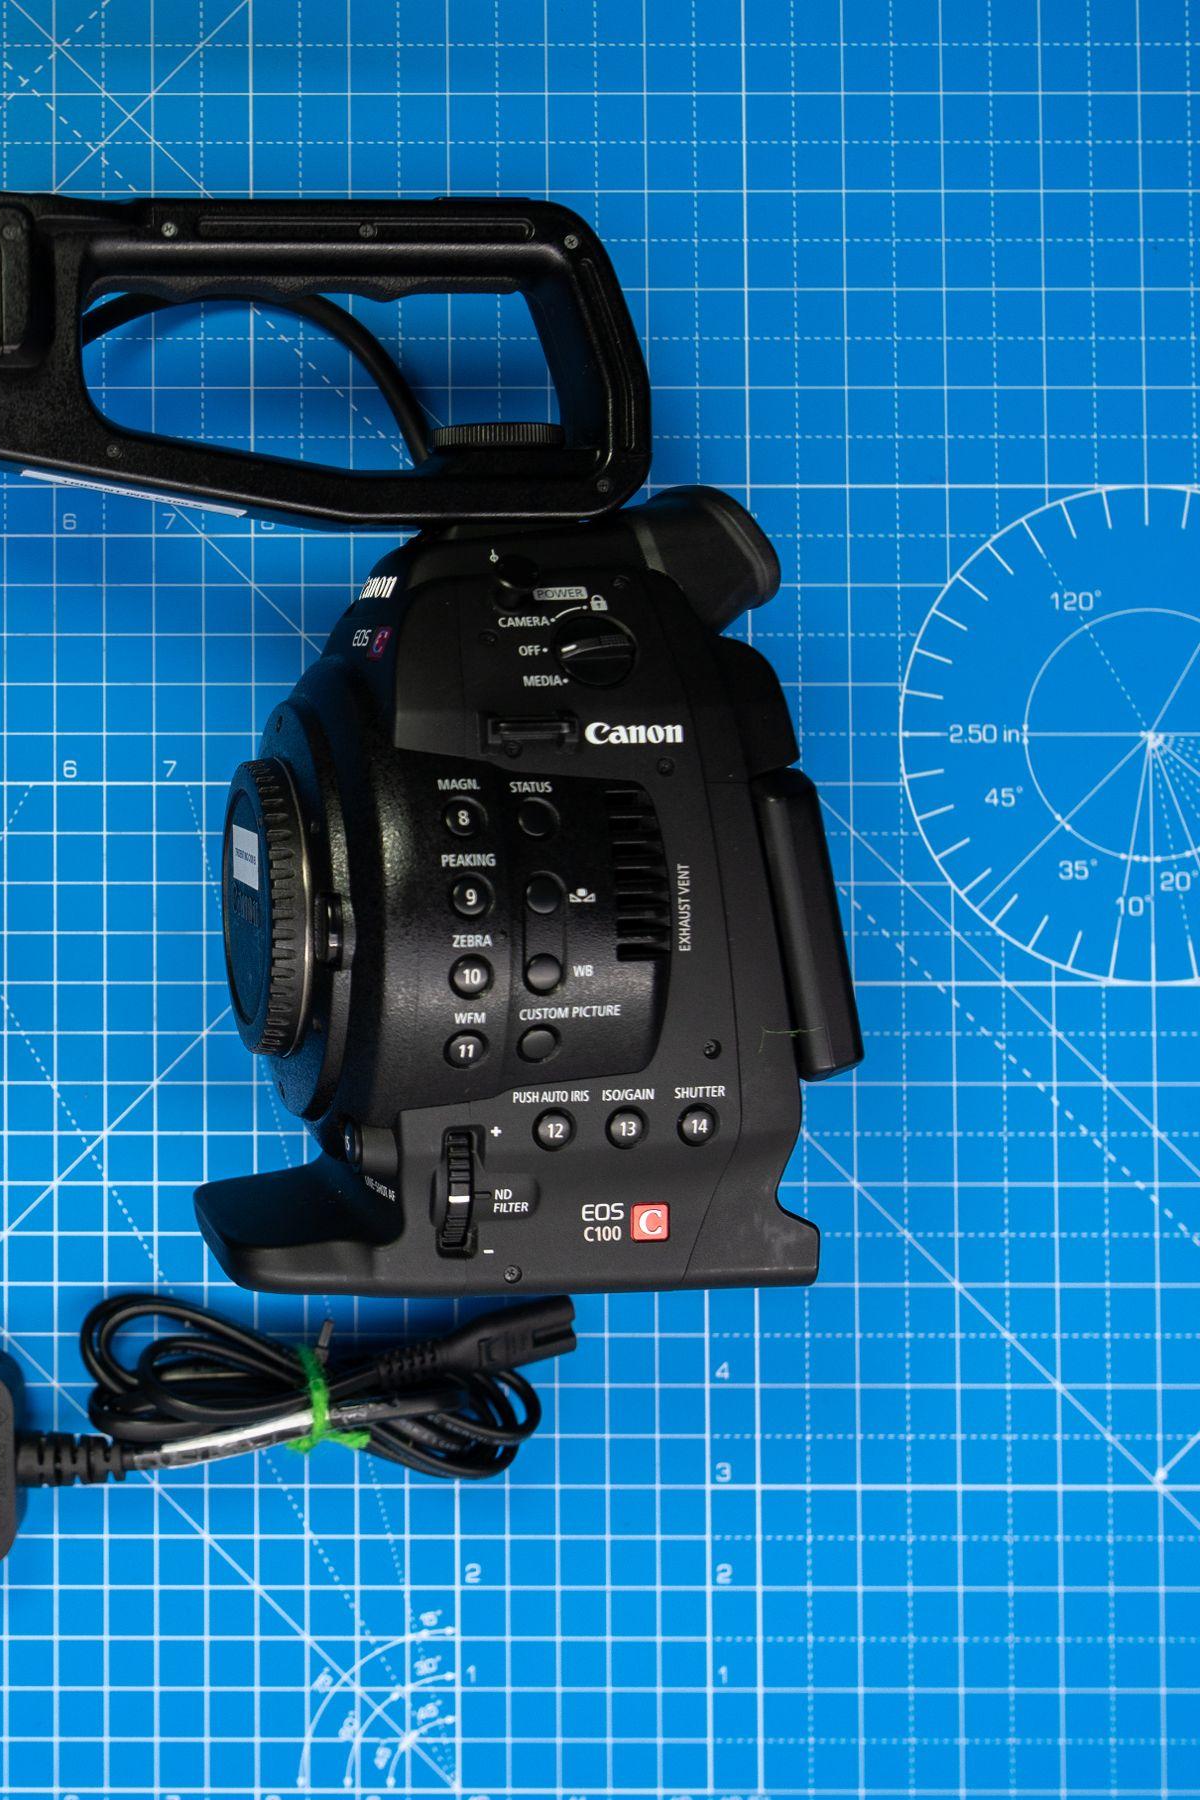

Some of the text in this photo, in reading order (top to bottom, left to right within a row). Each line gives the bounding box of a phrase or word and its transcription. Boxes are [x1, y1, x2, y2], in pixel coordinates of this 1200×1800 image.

[62, 513, 77, 530] 6
[162, 513, 177, 530] 7
[359, 575, 397, 600] anon
[536, 589, 584, 599] POWER
[1050, 590, 1102, 611] 120°
[498, 616, 549, 628] CAMERA
[352, 629, 372, 647] EOS
[518, 645, 540, 656] OFF
[523, 674, 562, 687] MEDIA
[585, 722, 684, 744] Canon
[949, 724, 1020, 744] 2.50 in
[62, 761, 77, 778] 6
[163, 761, 177, 778] 7
[437, 778, 480, 790] MAGN.
[509, 781, 552, 793] STATUS
[985, 787, 1023, 807] 45°
[458, 811, 469, 826] 8
[441, 853, 496, 867] PEAKING
[1059, 859, 1098, 880] 35°
[1160, 866, 1199, 890] 20°
[464, 887, 477, 906] 9
[677, 864, 692, 952] EXHAUST VENT
[452, 934, 493, 948] ZEBRA
[463, 968, 482, 984] 10
[573, 965, 594, 977] WB
[454, 1011, 486, 1024] WFM
[519, 1005, 621, 1020] CUSTOM PICTURE
[458, 1043, 475, 1058] 11
[512, 1089, 590, 1103] PUSH AUTO IRIS
[602, 1088, 655, 1101] ISO/GAIN
[674, 1086, 726, 1099] SHUTTER
[548, 1123, 563, 1138] 12
[620, 1121, 636, 1137] 13
[692, 1118, 708, 1134] 14
[495, 1188, 512, 1200] ND
[493, 1201, 529, 1214] FILTER
[581, 1203, 662, 1235] EOS C
[583, 1226, 622, 1242] C100
[715, 1361, 730, 1380] 4
[716, 1462, 732, 1482] 3
[464, 1564, 482, 1584] 2
[716, 1564, 733, 1584] 2
[466, 1665, 476, 1683] 1
[717, 1666, 730, 1684] 1
